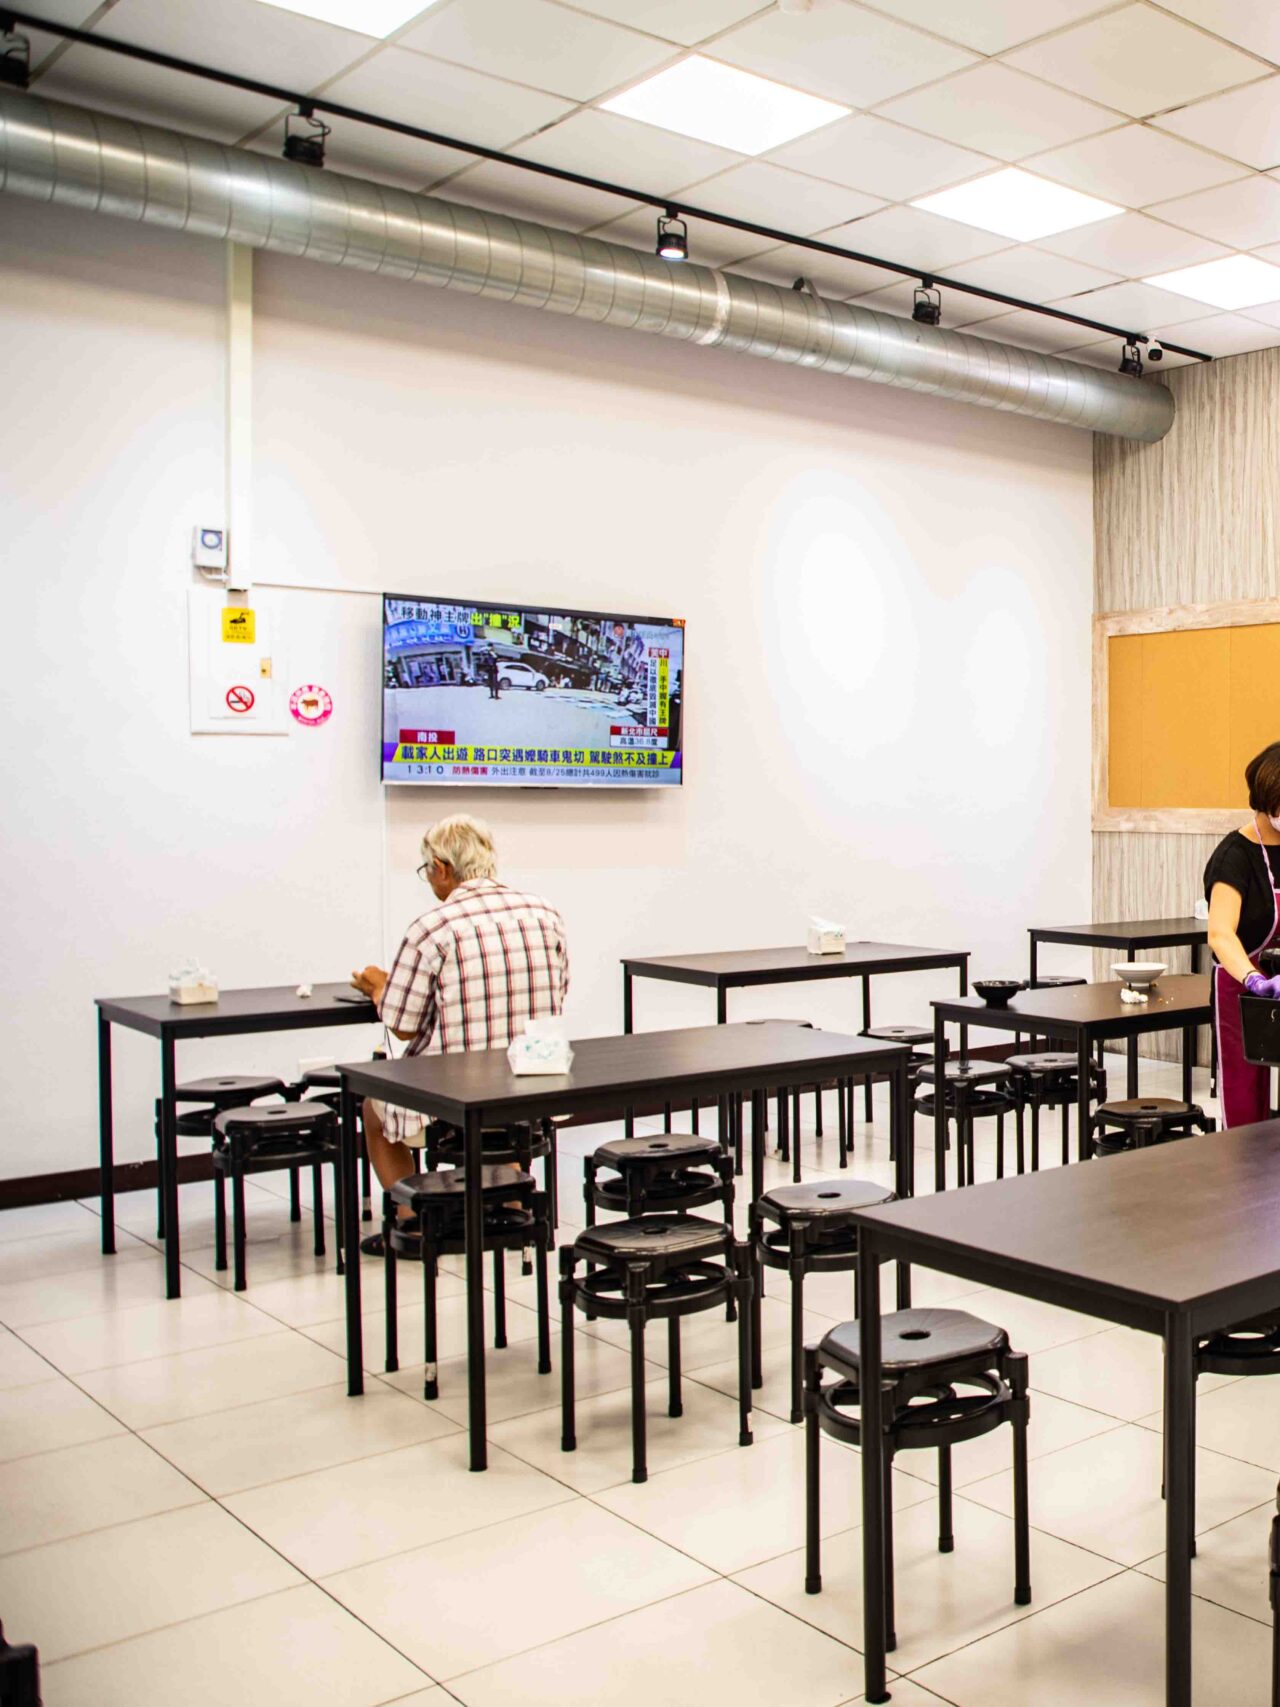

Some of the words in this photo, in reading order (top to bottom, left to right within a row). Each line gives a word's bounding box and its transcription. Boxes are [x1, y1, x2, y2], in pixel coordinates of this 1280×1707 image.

[417, 731, 438, 743] 南投
[401, 745, 468, 761] 載家人出遊
